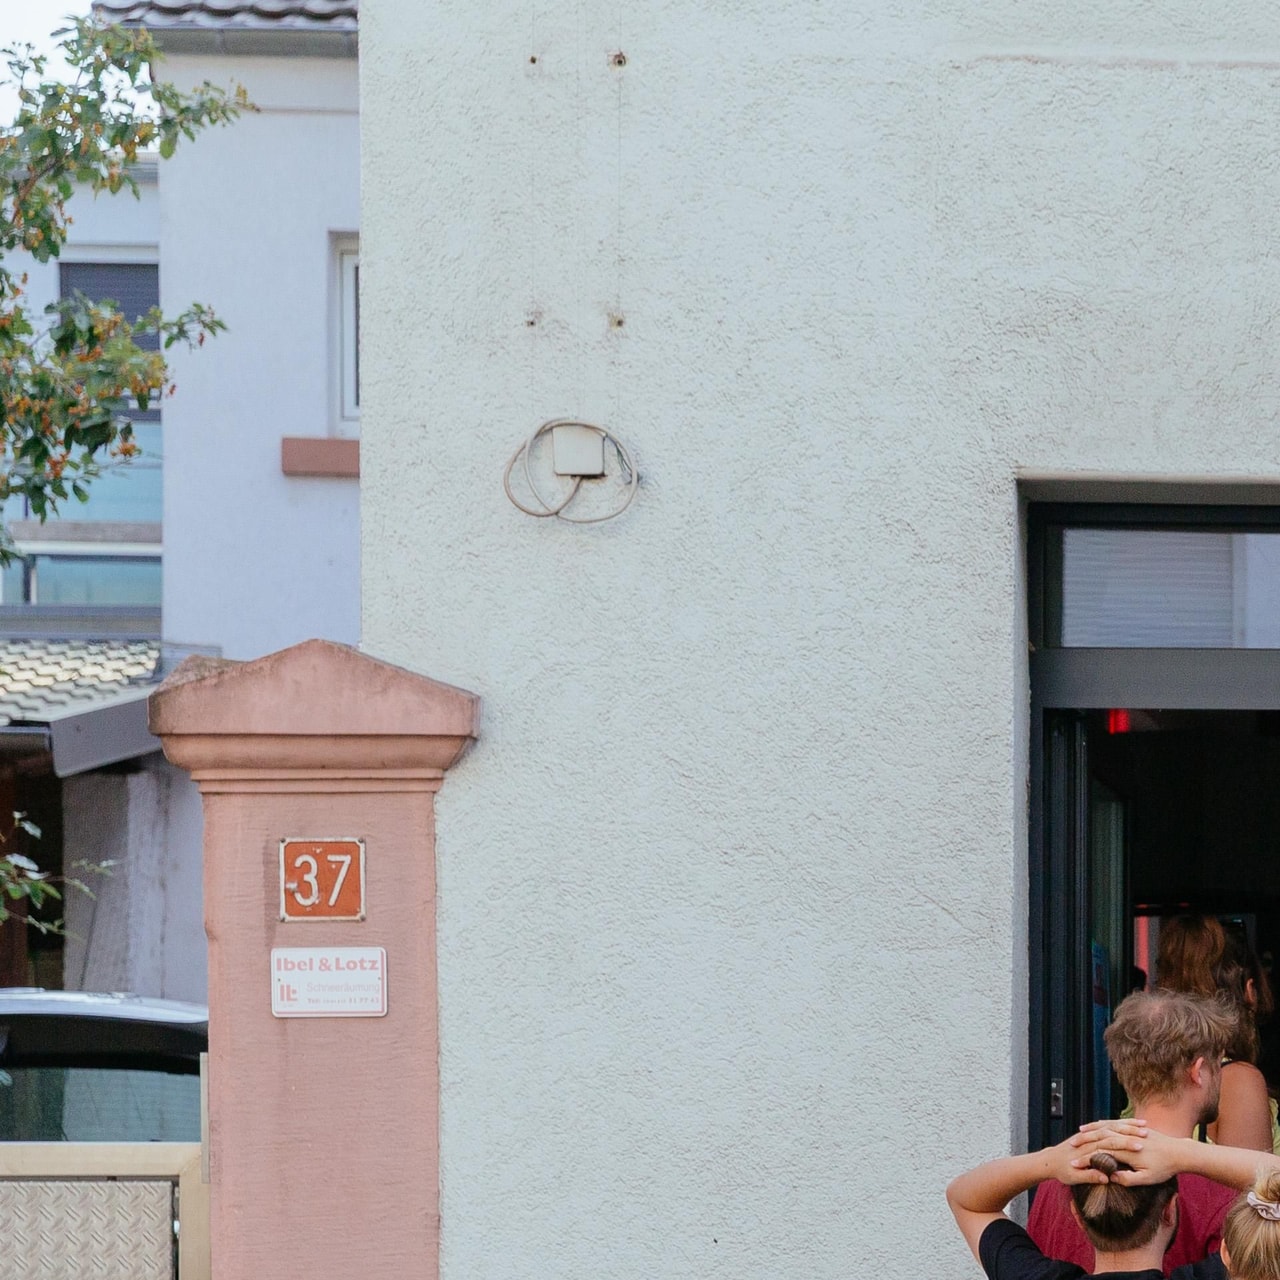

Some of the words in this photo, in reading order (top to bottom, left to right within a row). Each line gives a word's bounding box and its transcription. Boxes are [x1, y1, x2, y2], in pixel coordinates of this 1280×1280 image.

[294, 854, 352, 906] 37
[276, 957, 314, 971] Ibel
[318, 957, 332, 971] &
[335, 957, 379, 971] Lotz
[306, 982, 380, 994] Schneeräumung
